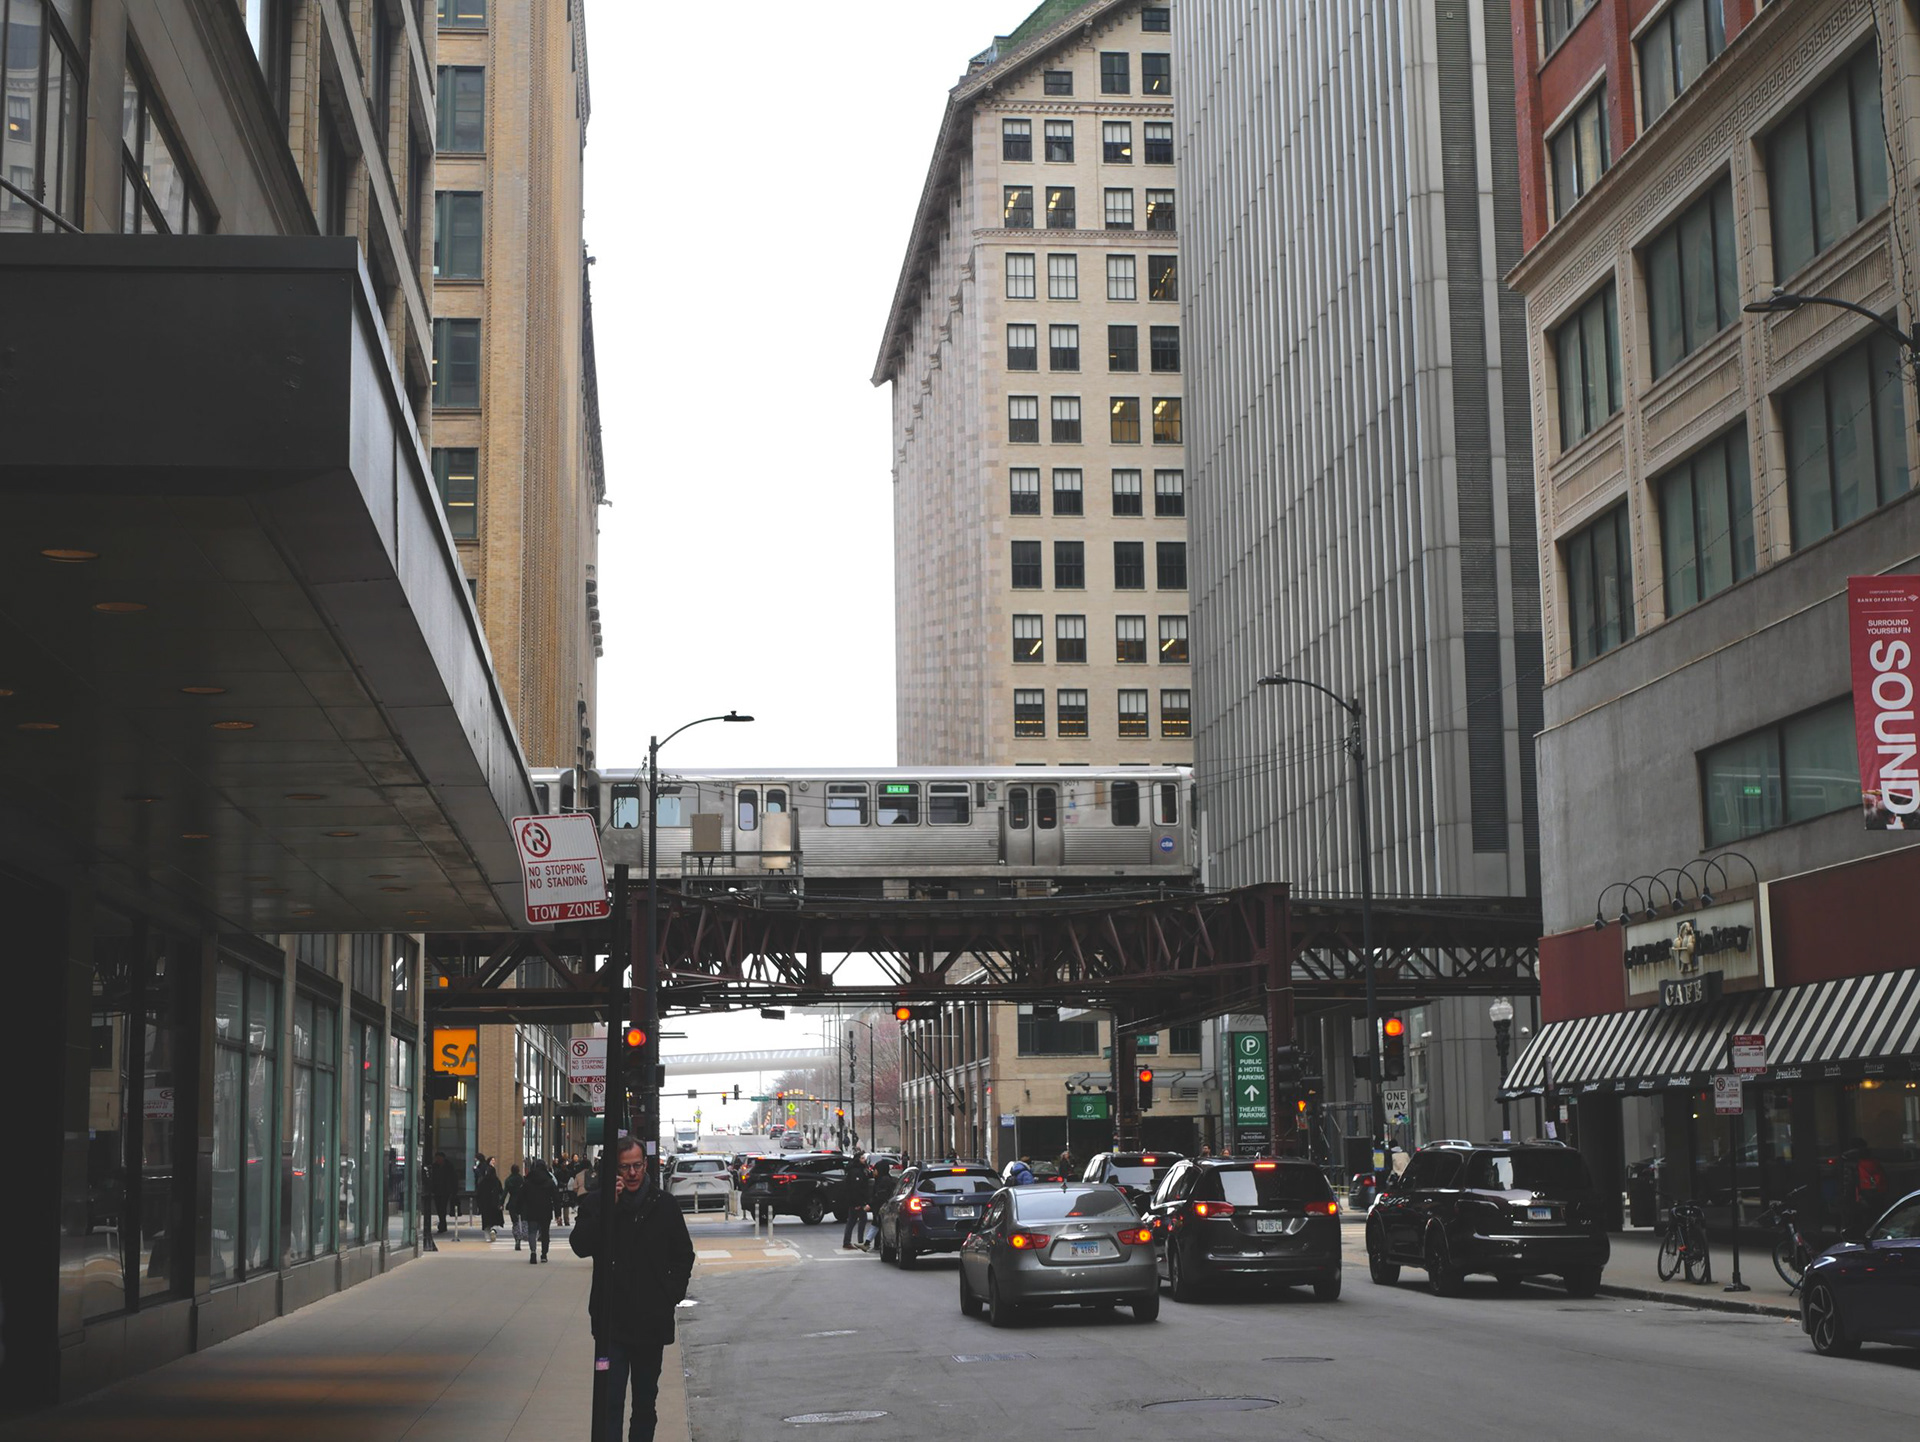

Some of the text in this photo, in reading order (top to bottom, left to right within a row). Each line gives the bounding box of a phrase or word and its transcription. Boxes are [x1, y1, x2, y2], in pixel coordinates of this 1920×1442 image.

[1868, 618, 1909, 627] SURROUND
[1866, 626, 1911, 635] YOURSELF IN
[1869, 640, 1920, 814] SOUND
[528, 863, 586, 877] NO STOPPING
[530, 875, 588, 889] NO STANDING
[532, 902, 602, 920] TOW ZONE
[1665, 979, 1702, 1006] CAFE
[1246, 1039, 1256, 1052] P
[1386, 1092, 1406, 1101] ONE
[1386, 1101, 1407, 1110] WAY
